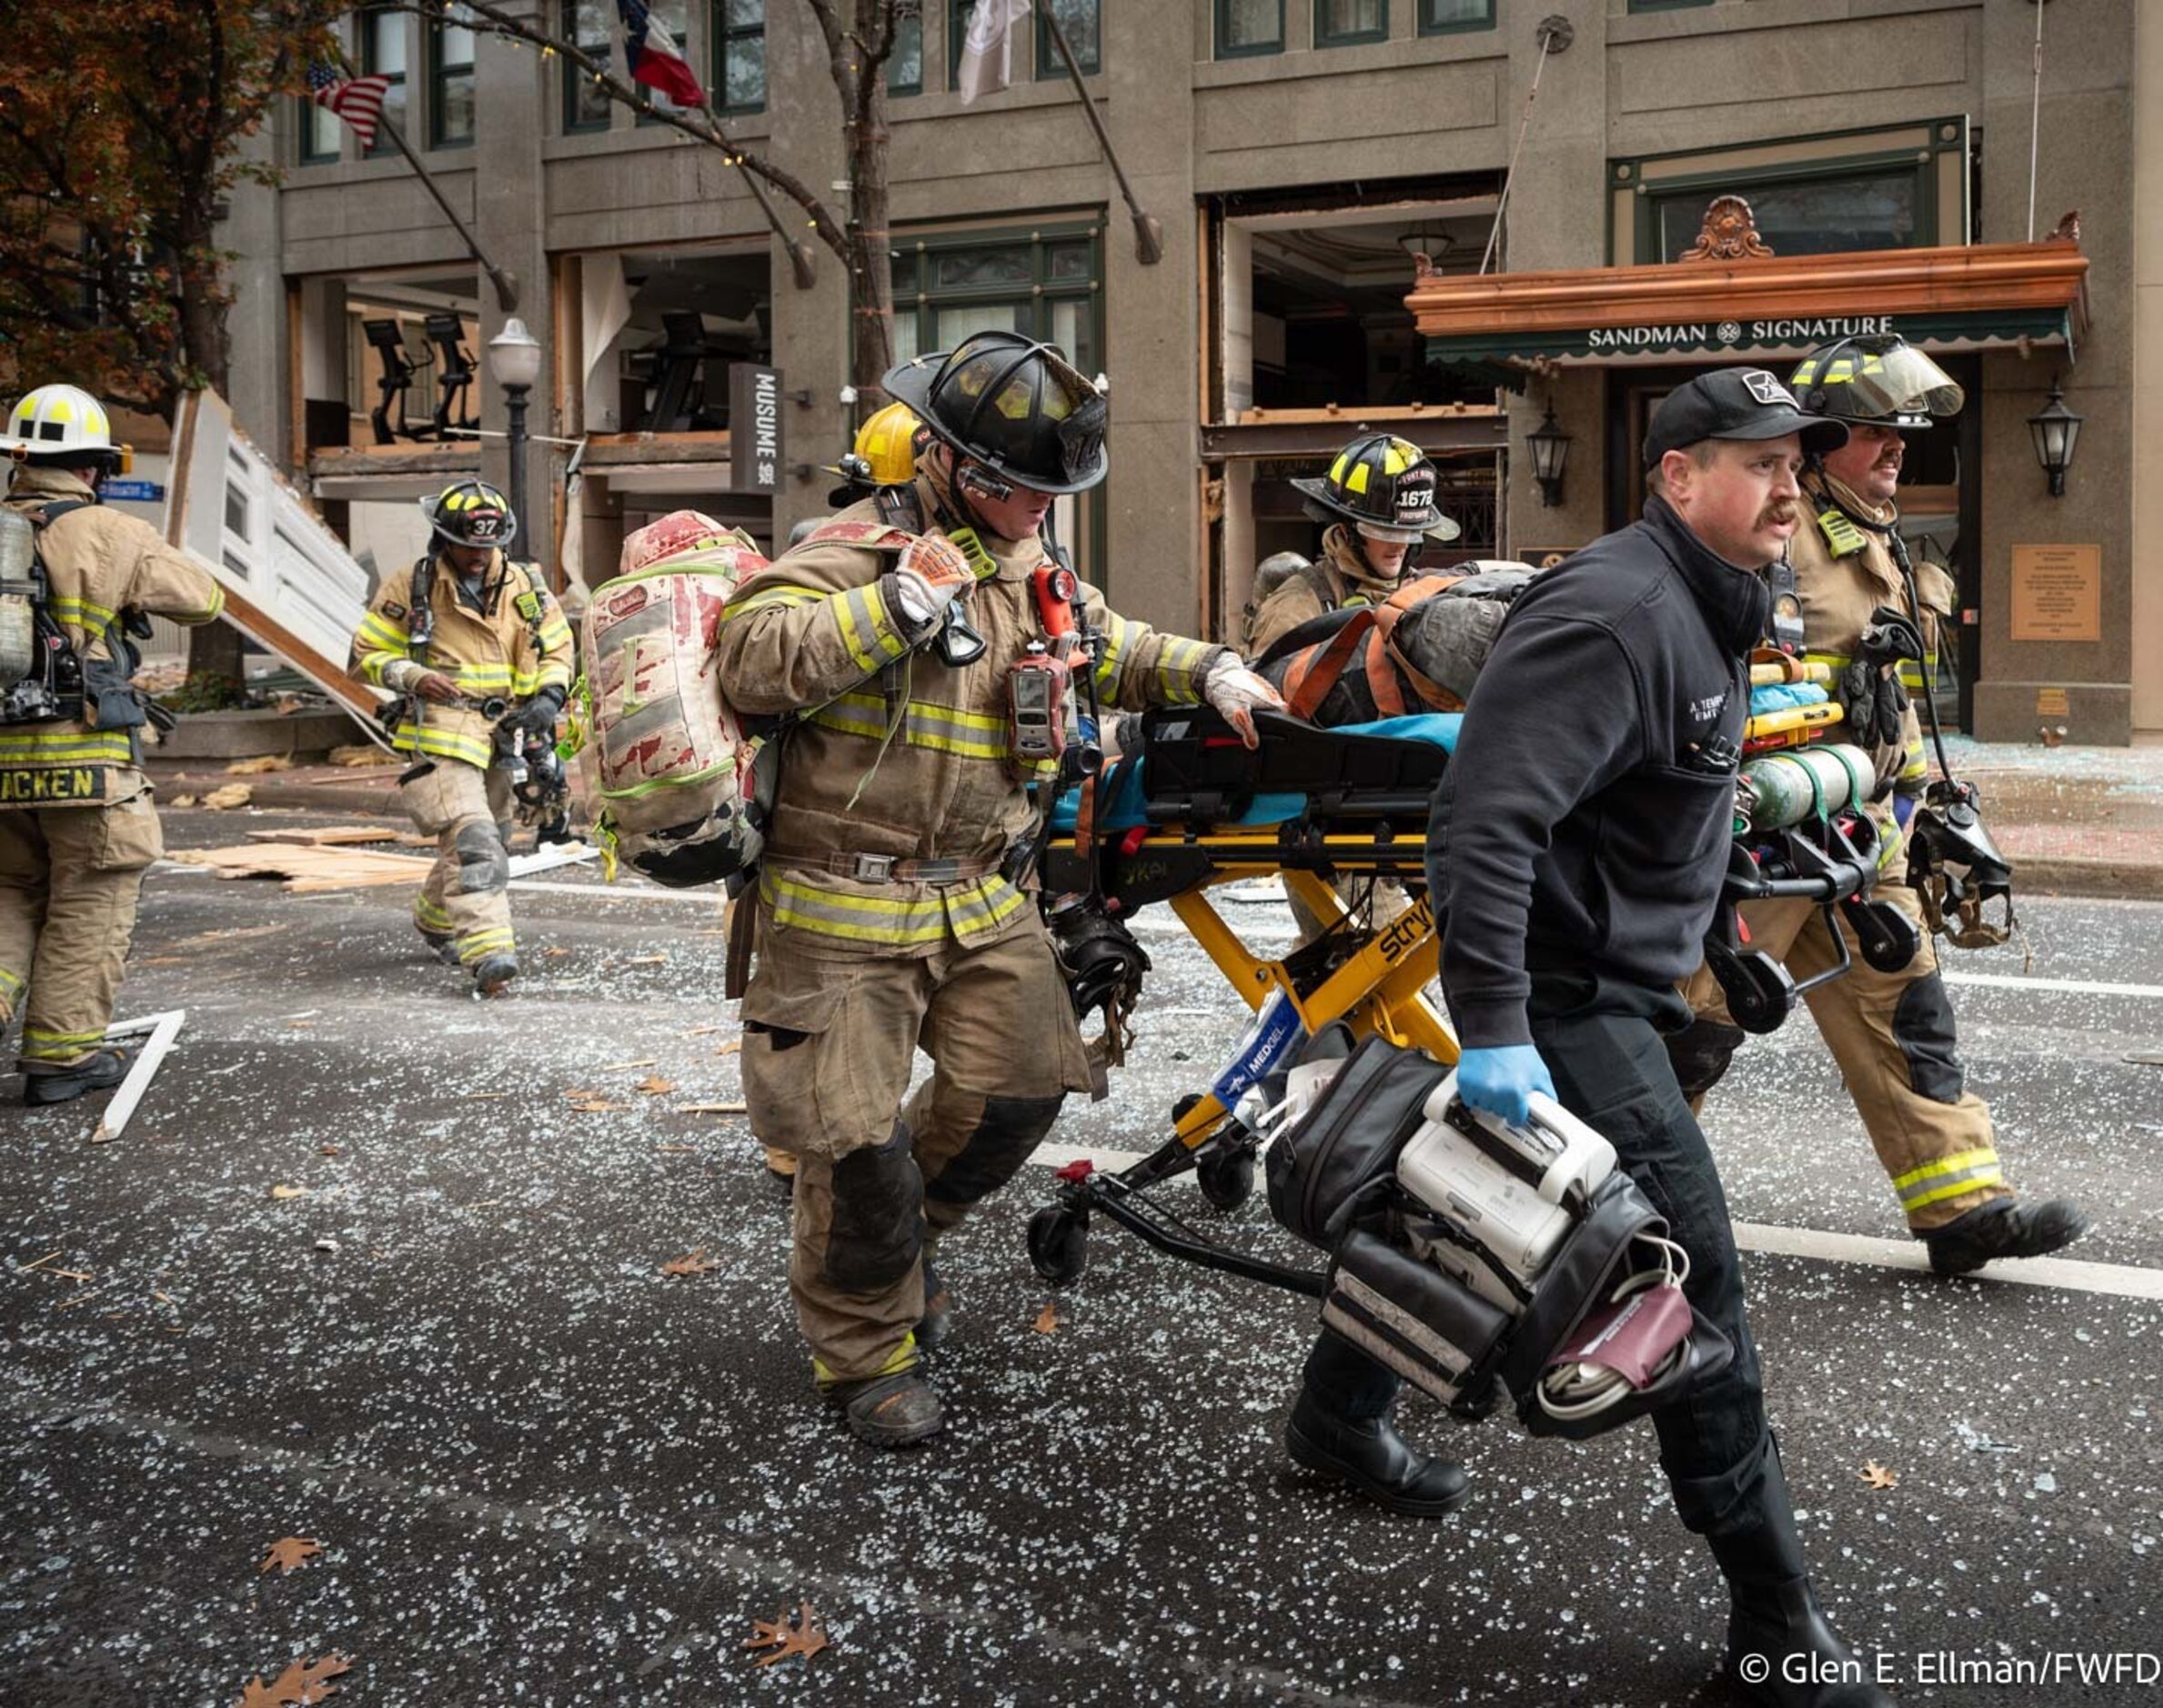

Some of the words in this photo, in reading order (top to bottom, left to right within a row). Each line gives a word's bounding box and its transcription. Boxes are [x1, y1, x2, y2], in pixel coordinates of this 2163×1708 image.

[1588, 324, 1706, 347] SANDMAN
[1752, 316, 1893, 339] SIGNATURE
[755, 373, 776, 457] MUSUME
[474, 519, 498, 535] 37
